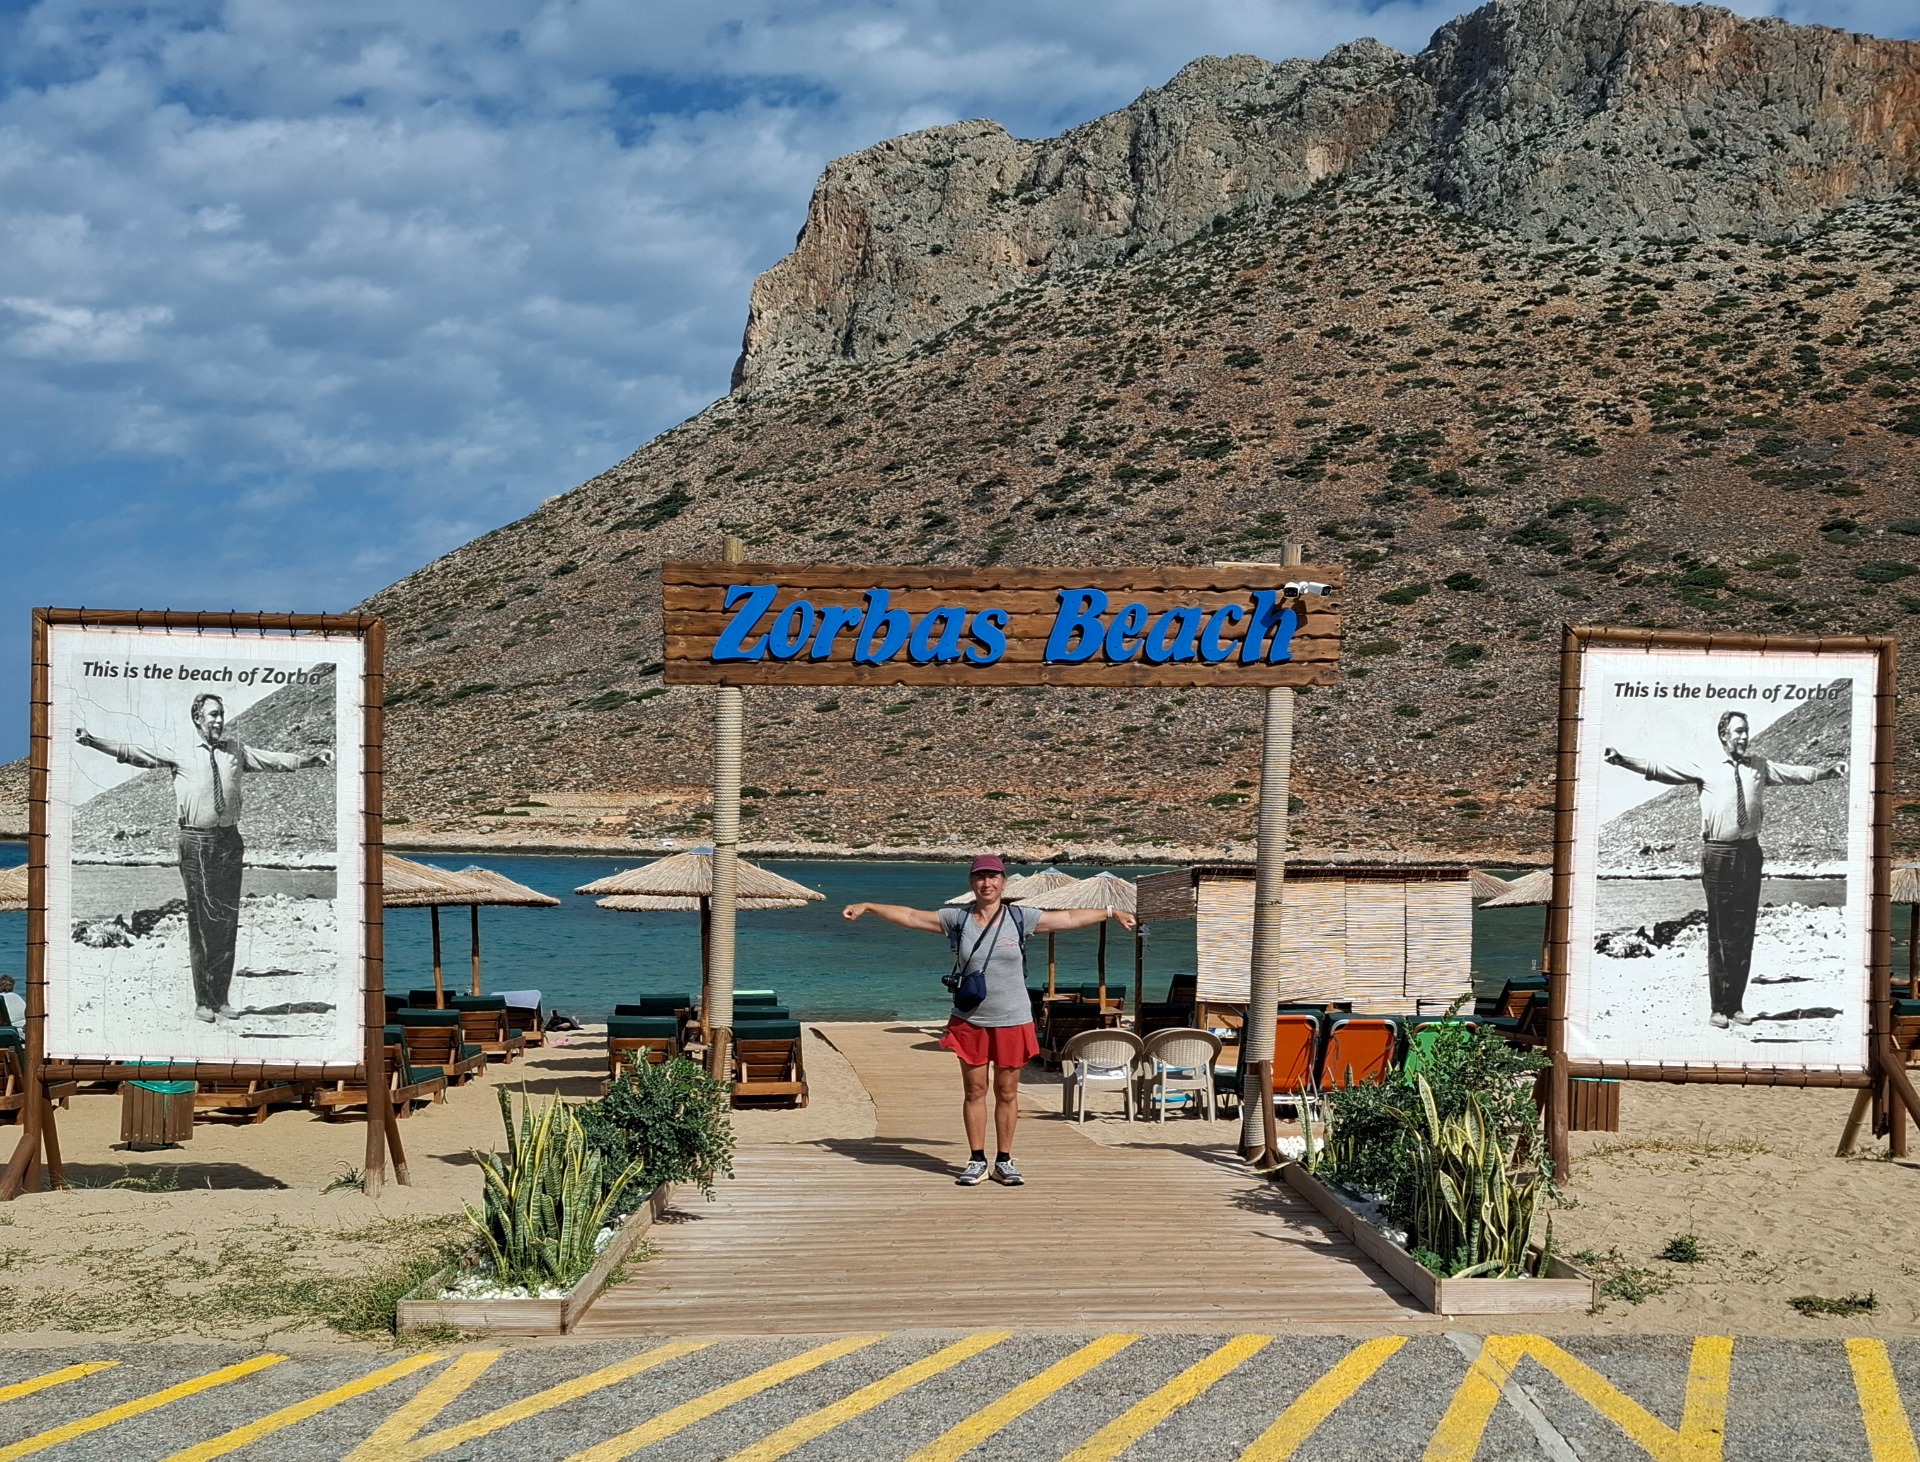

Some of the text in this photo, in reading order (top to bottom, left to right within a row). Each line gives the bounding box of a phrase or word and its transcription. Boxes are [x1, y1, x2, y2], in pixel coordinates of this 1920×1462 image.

[711, 584, 1299, 666] Zorbas Beach
[82, 660, 321, 687] This is the beach of Zorba
[1614, 681, 1839, 703] This is the beach of Zorba
